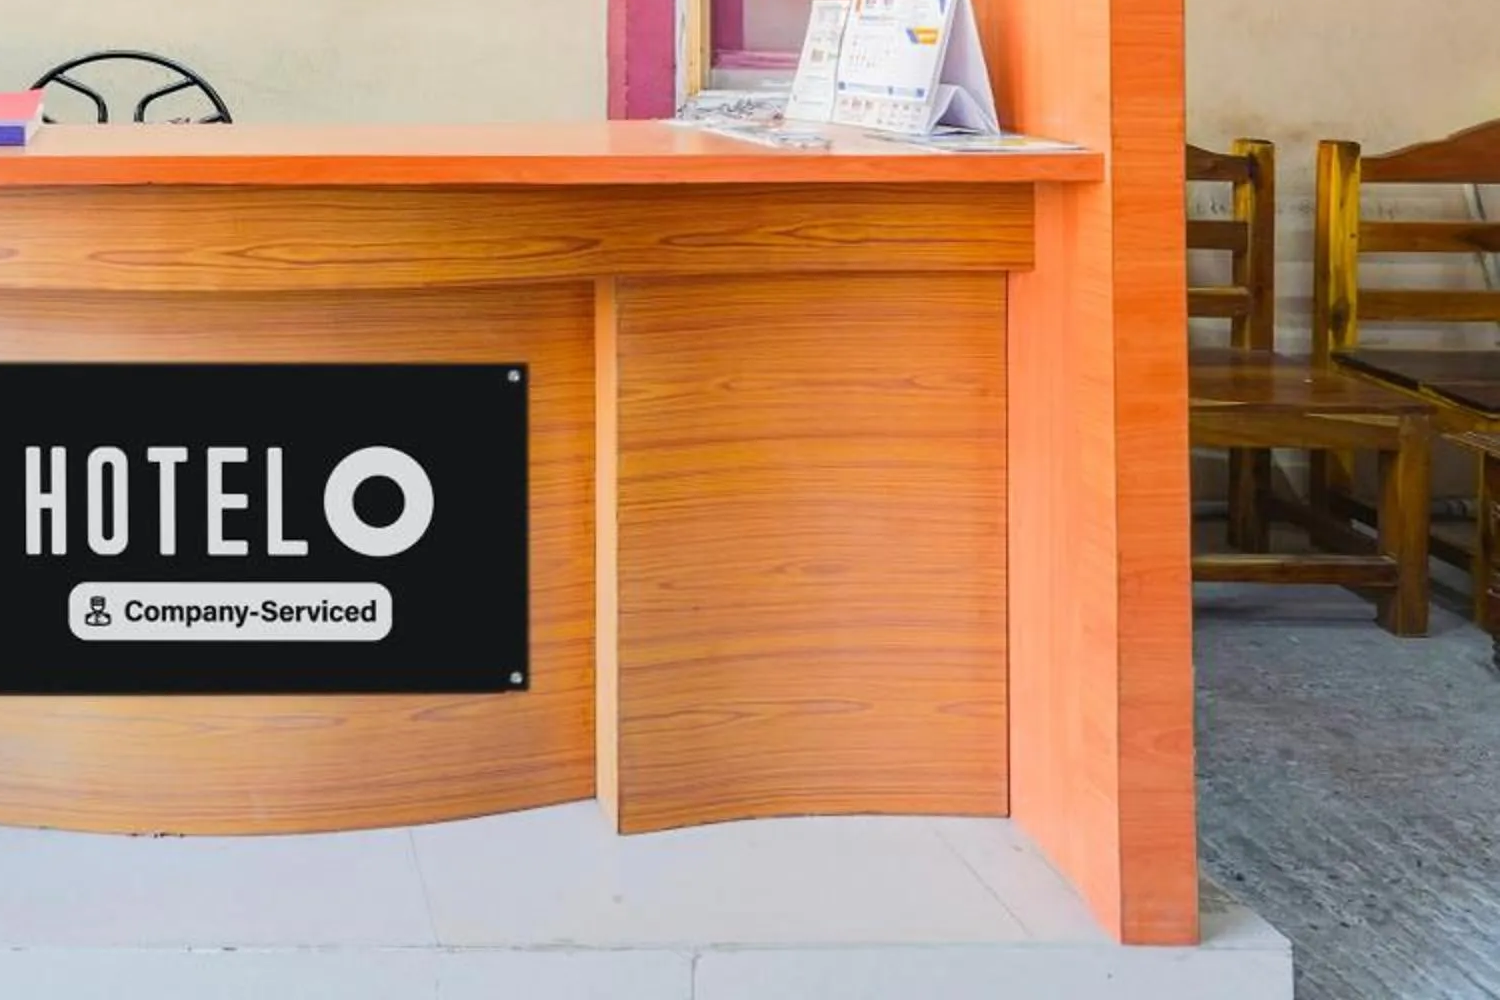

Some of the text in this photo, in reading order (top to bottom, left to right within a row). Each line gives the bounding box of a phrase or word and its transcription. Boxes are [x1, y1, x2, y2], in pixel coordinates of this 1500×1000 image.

[25, 446, 434, 557] HOTEL O
[124, 600, 377, 627] Company-Serviced
